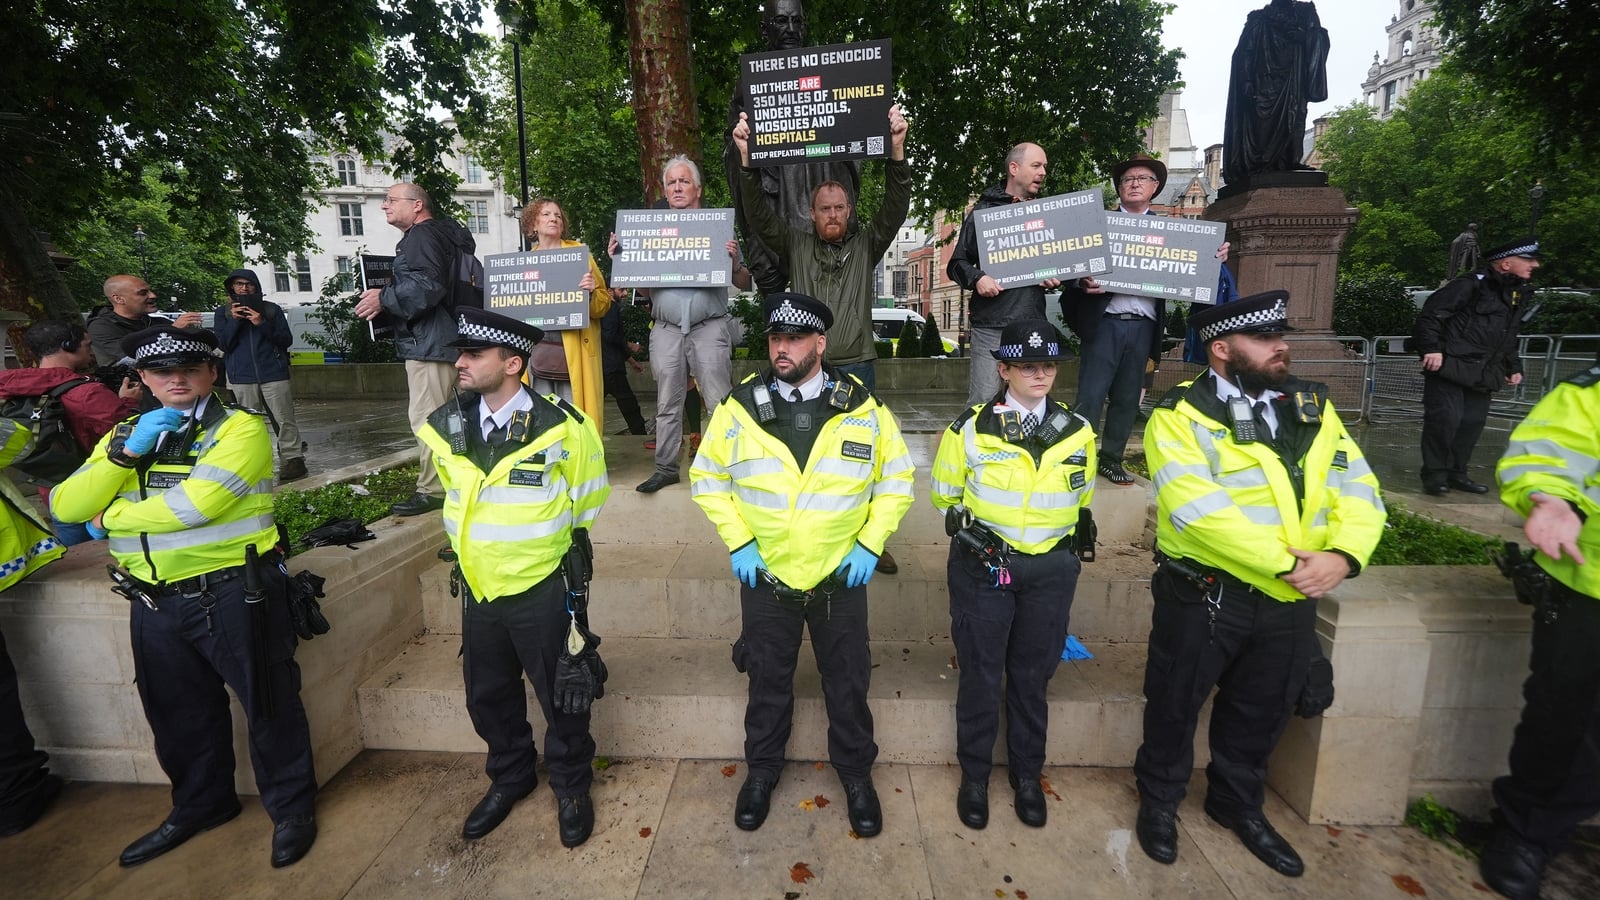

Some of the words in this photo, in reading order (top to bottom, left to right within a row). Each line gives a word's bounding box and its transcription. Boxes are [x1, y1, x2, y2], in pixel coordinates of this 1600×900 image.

[749, 57, 785, 72] THERE
[788, 56, 798, 68] IS
[801, 54, 818, 67] NO
[821, 47, 881, 65] GENOCIDE
[750, 83, 767, 94] BUT
[769, 80, 799, 93] THERE
[800, 78, 819, 89] ARE
[753, 95, 775, 108] 350
[778, 93, 811, 106] MILES
[814, 90, 828, 101] OF
[832, 85, 884, 100] TUNNELS
[755, 107, 792, 120] UNDER
[794, 101, 851, 117] SCHOOLS,
[756, 119, 810, 133] MOSQUES
[812, 116, 835, 128] AND
[756, 130, 816, 145] HOSPITALS
[752, 151, 768, 159] STOP
[769, 149, 804, 158] REPEATING
[806, 146, 830, 155] HAMAS
[982, 209, 1012, 222] THERE
[1014, 207, 1024, 217] IS
[1026, 204, 1040, 215] NO
[1043, 194, 1094, 212] GENOCIDE
[680, 213, 726, 221] GENOCIDE
[1106, 216, 1136, 227] THERE
[1139, 219, 1148, 228] IS
[1150, 220, 1165, 230] NO
[1167, 222, 1218, 235] GENOCIDE
[983, 229, 998, 238] BUT
[1000, 224, 1025, 234] THERE
[1026, 220, 1044, 230] ARE
[622, 239, 639, 249] 50
[642, 237, 710, 249] HOSTAGES
[986, 240, 996, 251] 2
[998, 229, 1055, 249] MILLION
[1121, 234, 1146, 242] THERE
[1146, 235, 1164, 245] ARE
[621, 250, 655, 262] STILL
[658, 250, 711, 261] CAPTIVE
[988, 245, 1039, 264] HUMAN
[1042, 234, 1103, 255] SHIELDS
[1126, 244, 1198, 262] HOSTAGES
[490, 258, 515, 268] THERE
[526, 256, 538, 265] NO
[540, 253, 582, 264] GENOCIDE
[1111, 255, 1137, 268] TILL
[1140, 260, 1197, 275] CAPTIVE
[1002, 273, 1034, 284] REPEATING
[1035, 270, 1057, 278] HAMAS
[491, 284, 498, 295] 2
[501, 281, 546, 294] MILLION
[1110, 281, 1141, 289] REPEATING
[1142, 284, 1164, 292] HAMAS
[491, 295, 532, 308] HUMAN
[535, 291, 583, 305] SHIELDS
